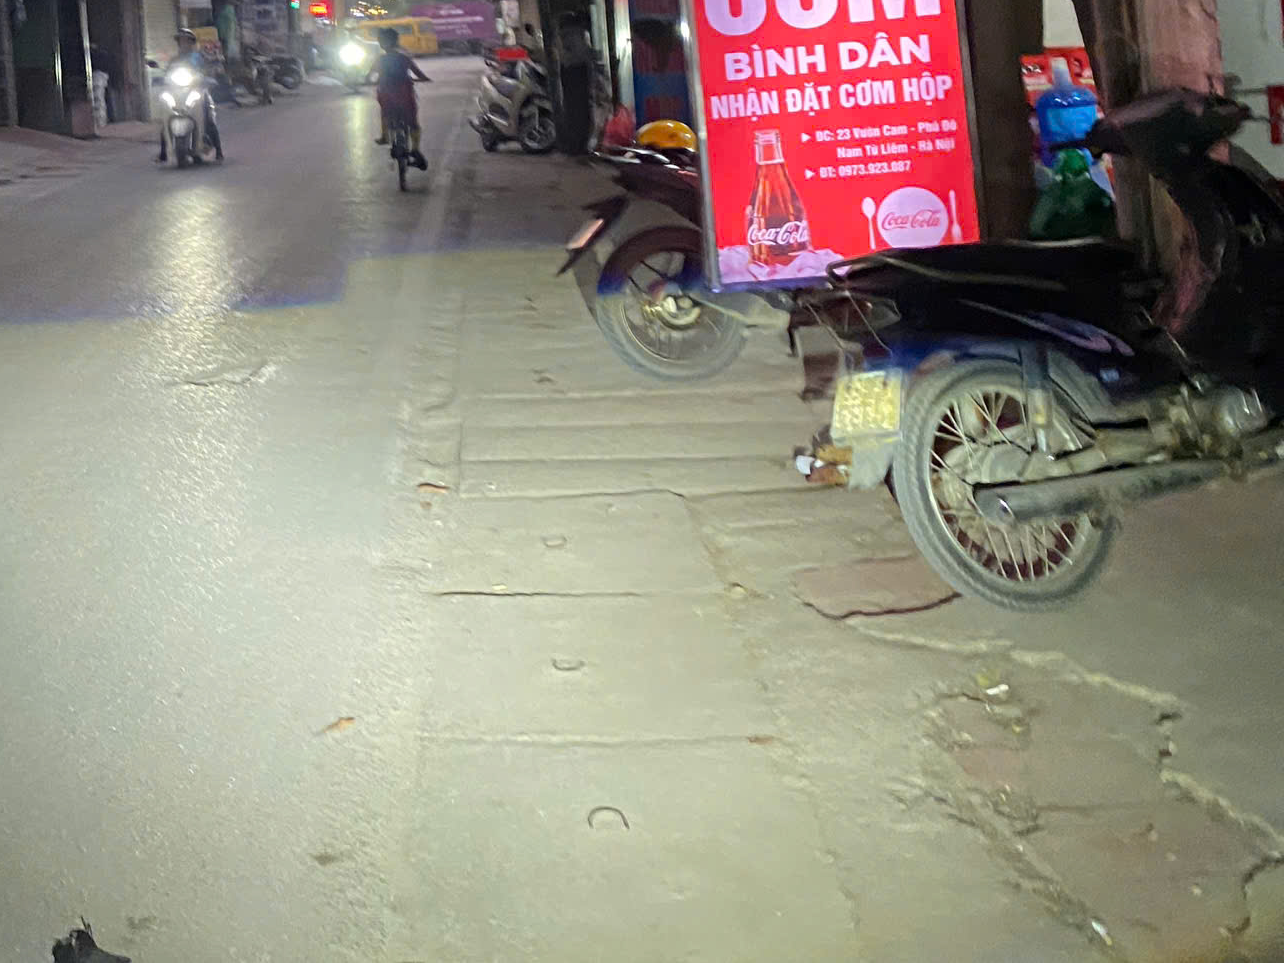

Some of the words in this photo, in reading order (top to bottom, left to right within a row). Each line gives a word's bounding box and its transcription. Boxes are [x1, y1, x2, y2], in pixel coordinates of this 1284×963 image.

[724, 44, 827, 81] BÌNH
[837, 32, 931, 70] DÂN
[710, 88, 780, 122] NHẬN
[785, 82, 832, 116] ĐẶT
[839, 79, 896, 108] CƠM
[901, 71, 953, 106] HỘP
[836, 128, 851, 140] 23
[882, 124, 908, 136] Cam
[836, 146, 863, 158] Nam
